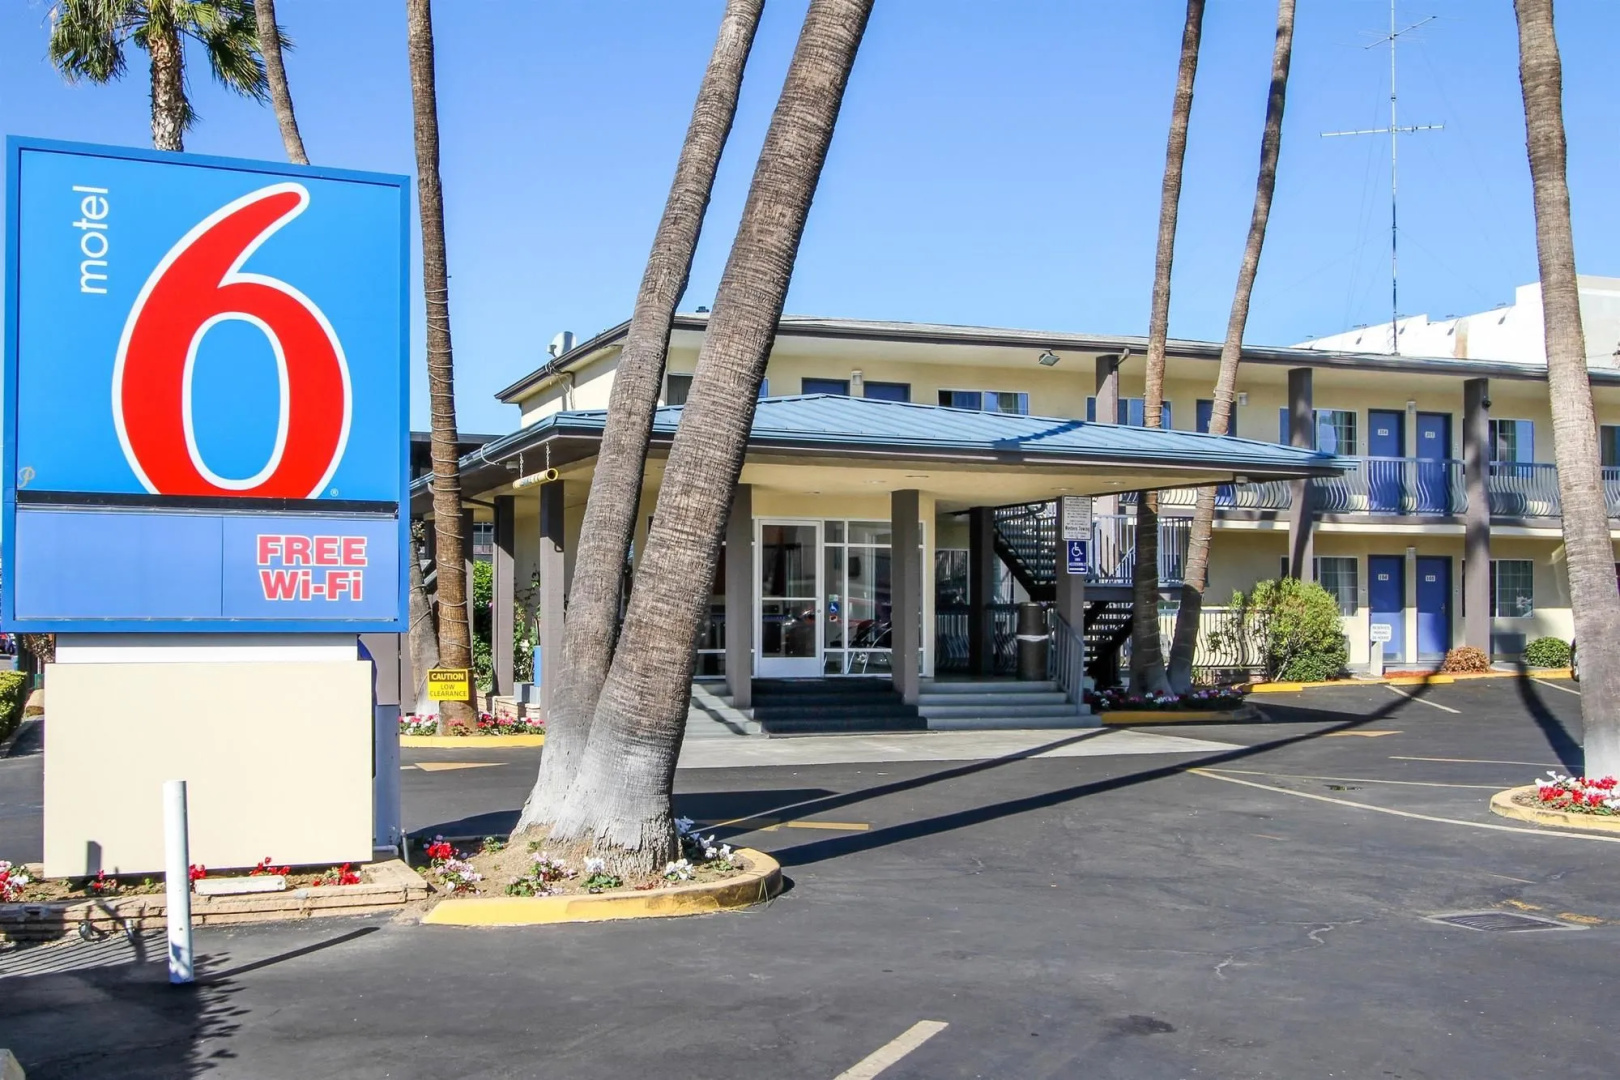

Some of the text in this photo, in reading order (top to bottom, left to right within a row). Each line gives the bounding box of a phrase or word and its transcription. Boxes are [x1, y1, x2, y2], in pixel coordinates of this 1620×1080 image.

[73, 186, 109, 294] motel
[111, 181, 353, 499] 6
[256, 533, 368, 567] FREE
[258, 569, 362, 602] Wi-Fi
[431, 672, 464, 681] CAUTION
